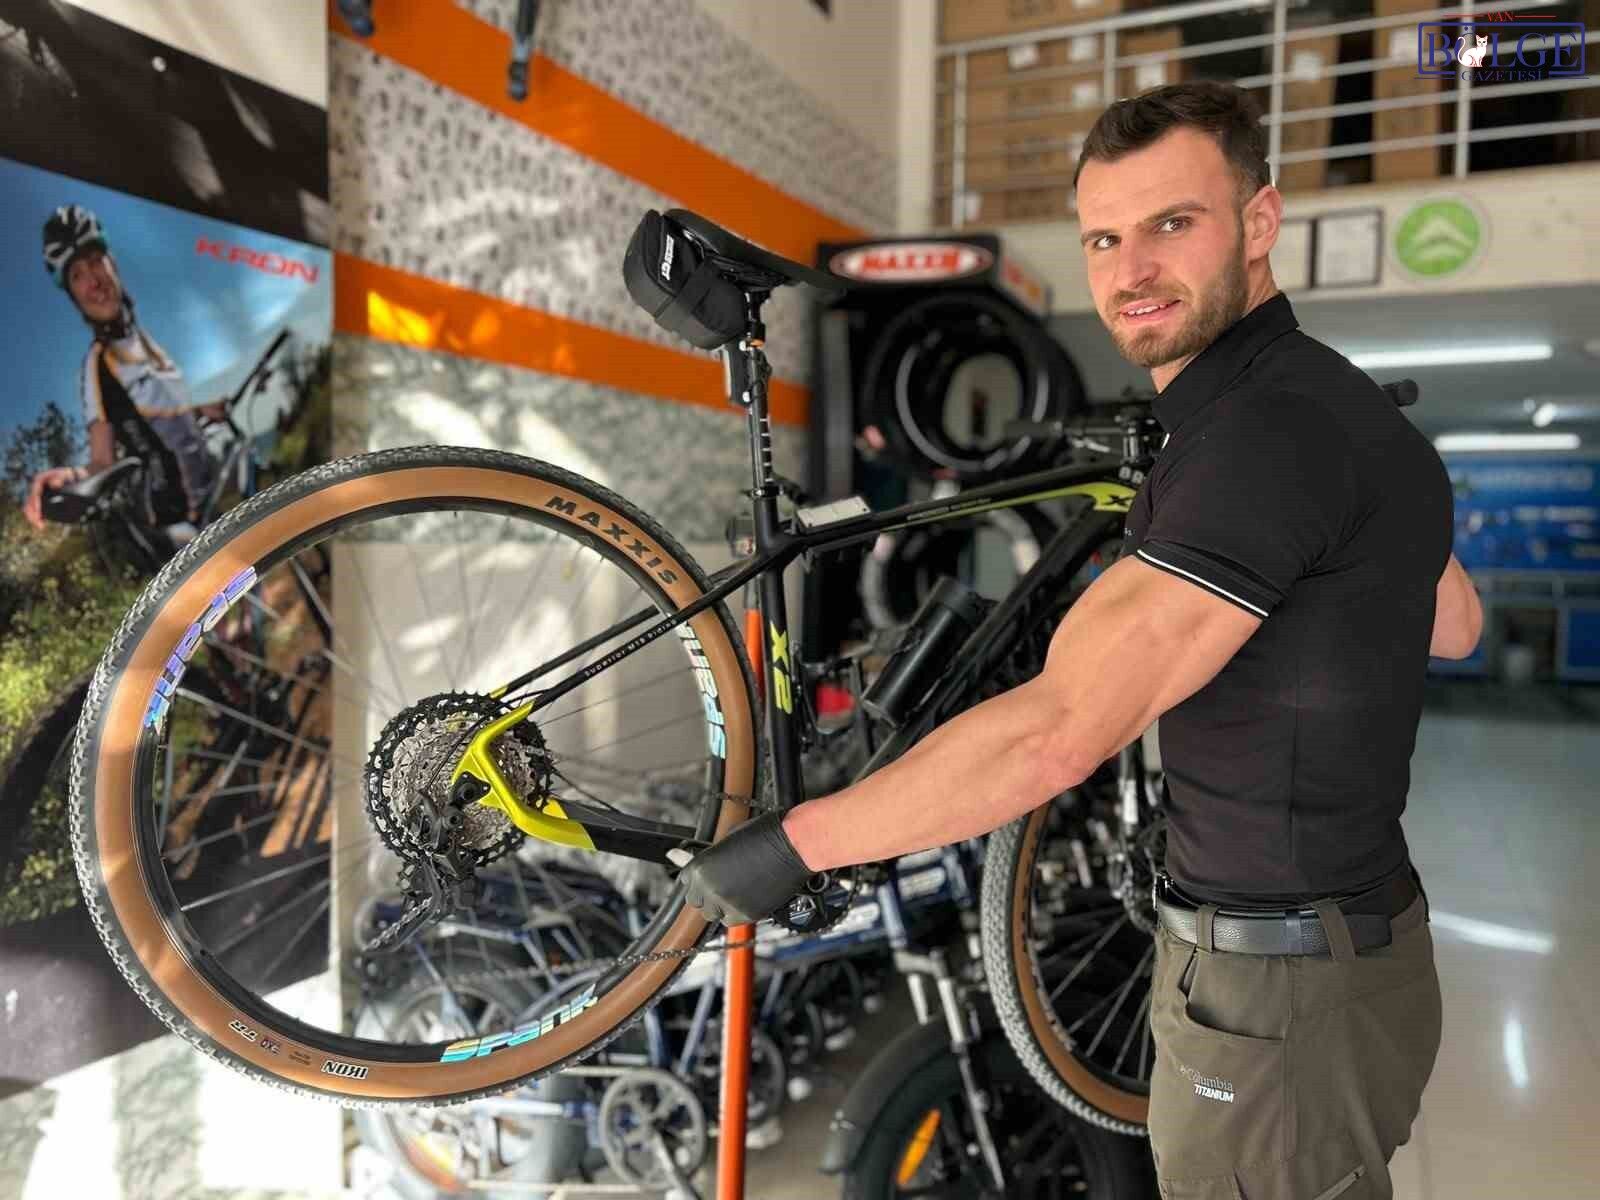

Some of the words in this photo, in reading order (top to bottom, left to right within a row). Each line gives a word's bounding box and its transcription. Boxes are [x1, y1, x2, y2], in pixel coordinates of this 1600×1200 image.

[196, 236, 320, 284] KRON
[545, 495, 679, 585] MAXXIS
[228, 1019, 259, 1043] TR
[320, 1059, 369, 1080] IKON
[1193, 1083, 1235, 1103] TITANIUM
